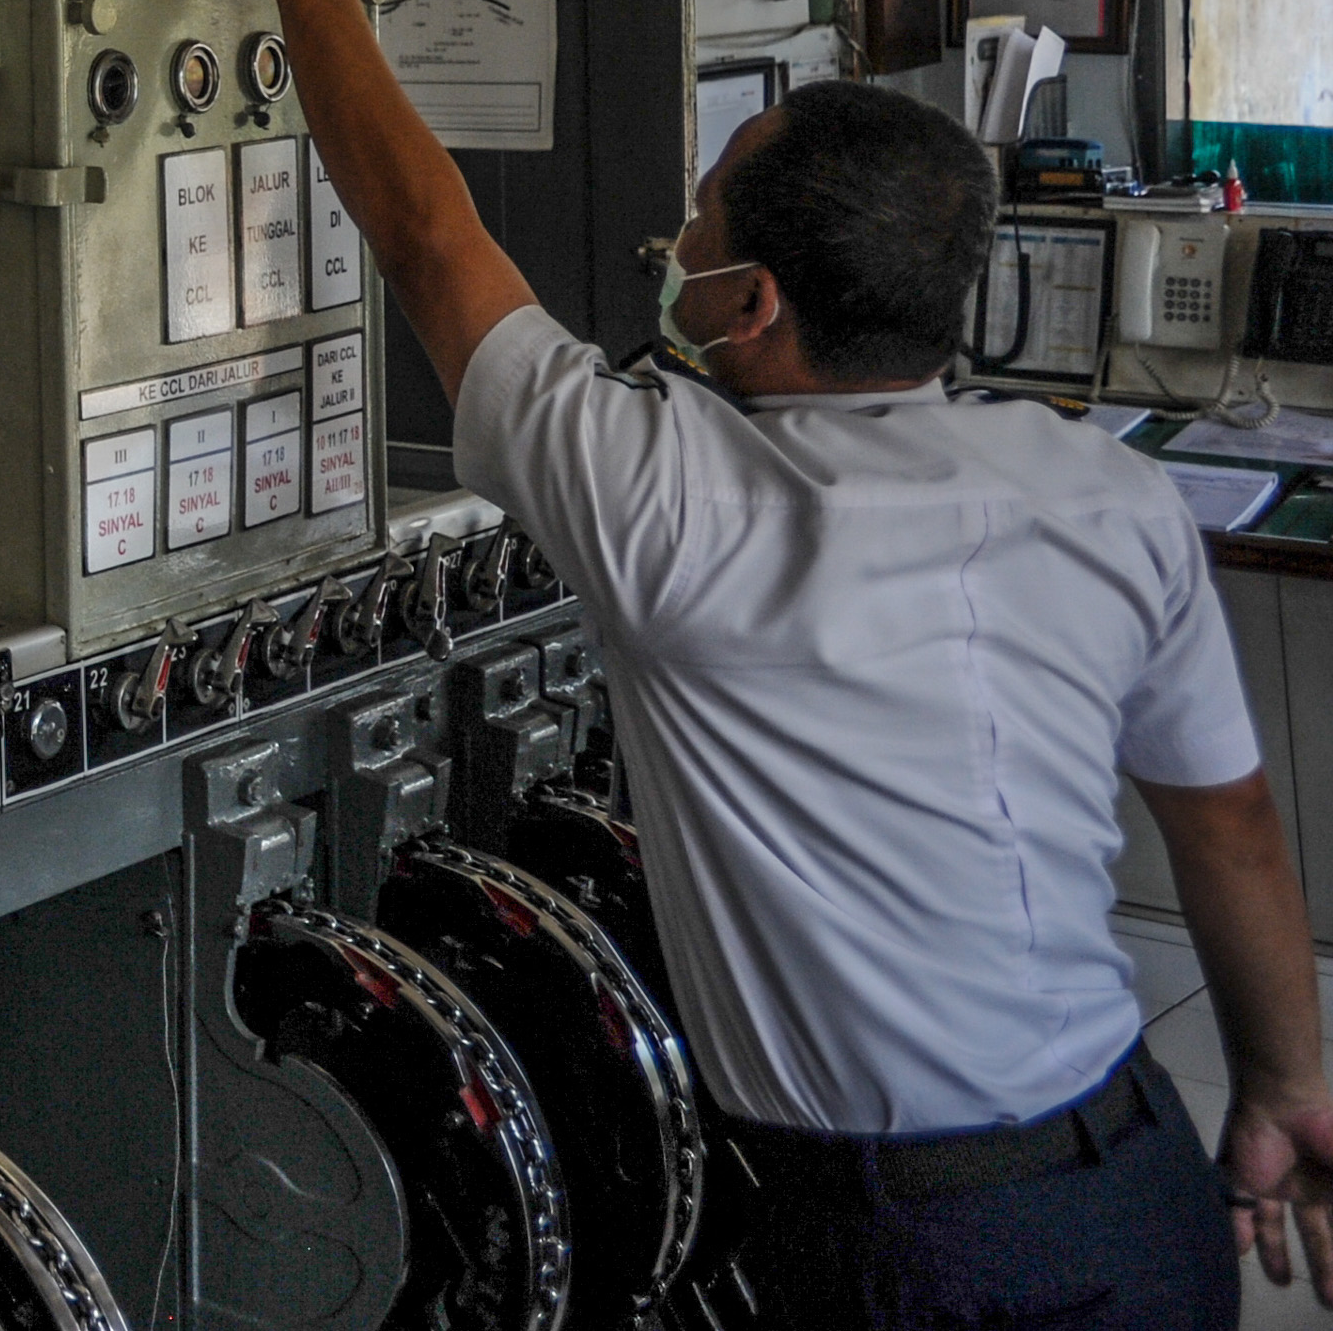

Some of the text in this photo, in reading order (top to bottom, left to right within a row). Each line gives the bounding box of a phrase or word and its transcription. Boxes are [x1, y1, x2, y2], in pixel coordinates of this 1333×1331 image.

[250, 171, 290, 195] JALUR
[178, 183, 215, 207] BLOK
[330, 210, 341, 228] DI
[247, 219, 295, 242] TUNGGAL
[189, 235, 207, 254] KE
[325, 258, 347, 276] CCL
[139, 360, 260, 402] KE CCL DARI JALUR
[90, 669, 108, 689] 22
[14, 690, 31, 712] 21
